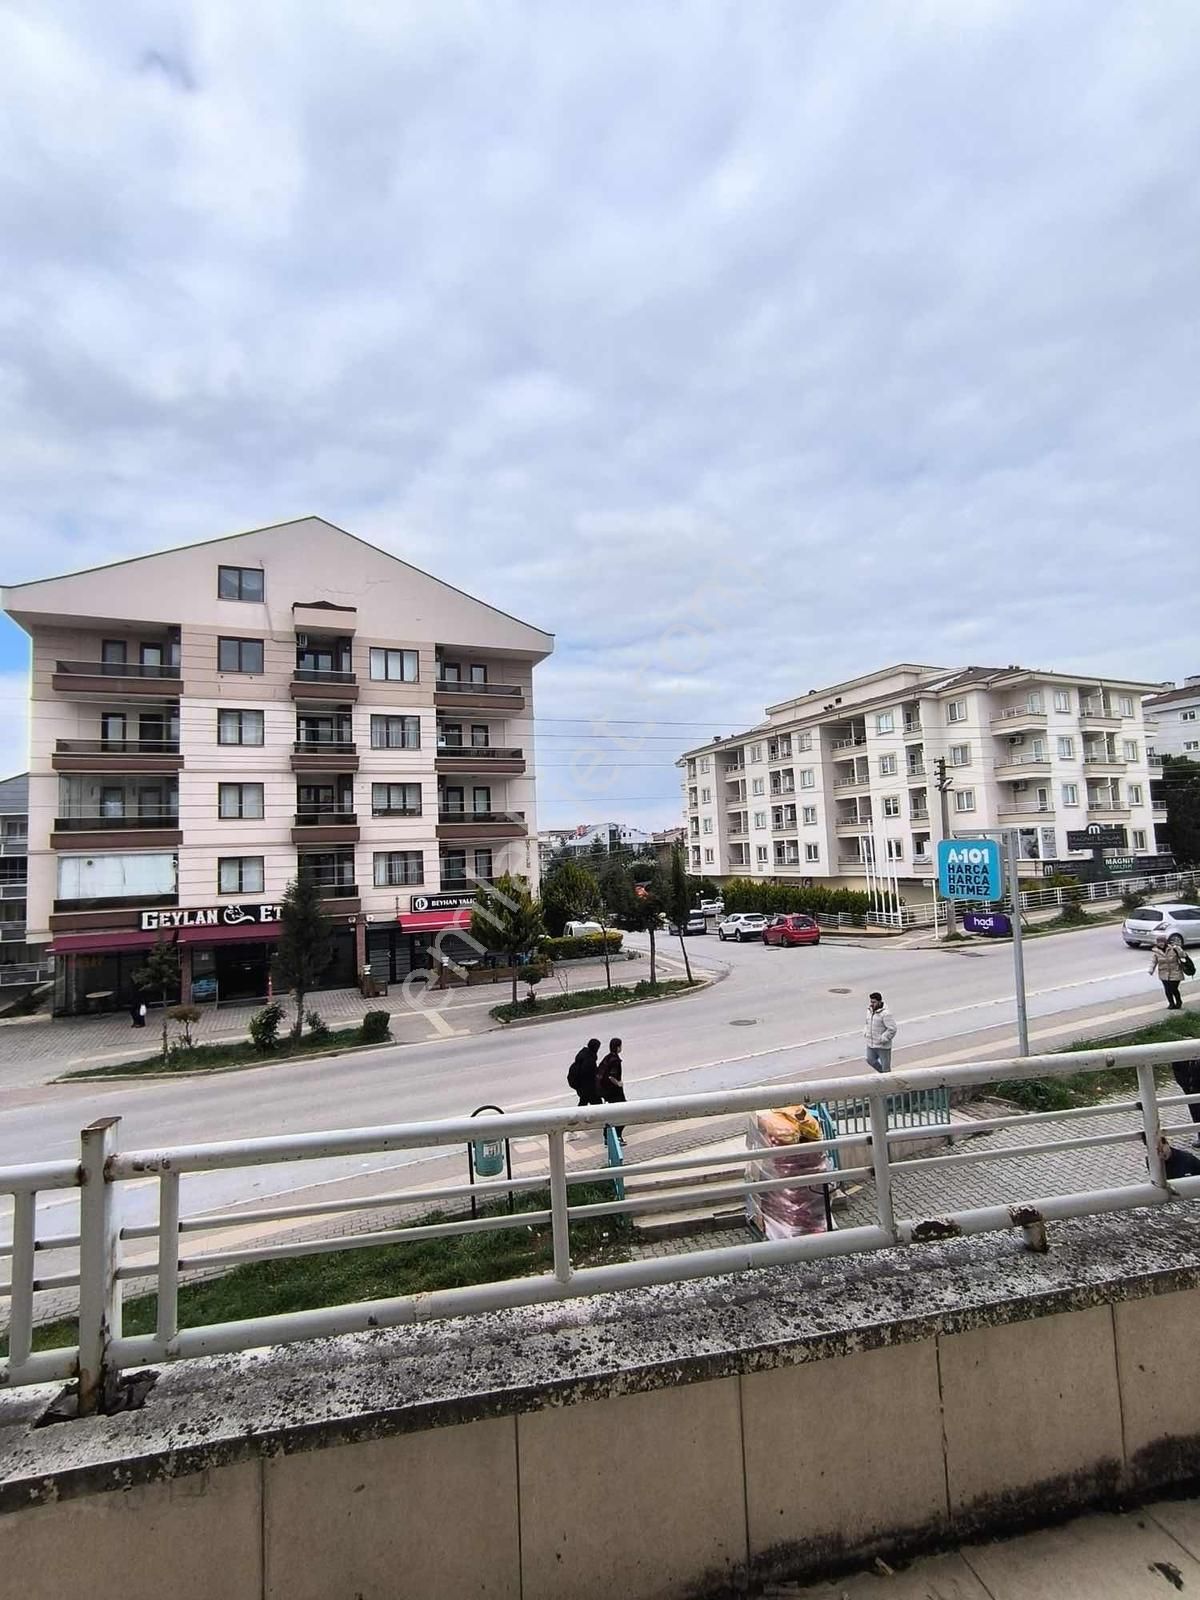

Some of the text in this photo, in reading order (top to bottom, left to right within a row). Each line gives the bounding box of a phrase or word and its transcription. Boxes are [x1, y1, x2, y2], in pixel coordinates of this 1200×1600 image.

[947, 864, 990, 875] HARCA
[948, 875, 991, 885] HARCA
[141, 909, 219, 930] GEYLAN
[973, 917, 994, 927] hadi
